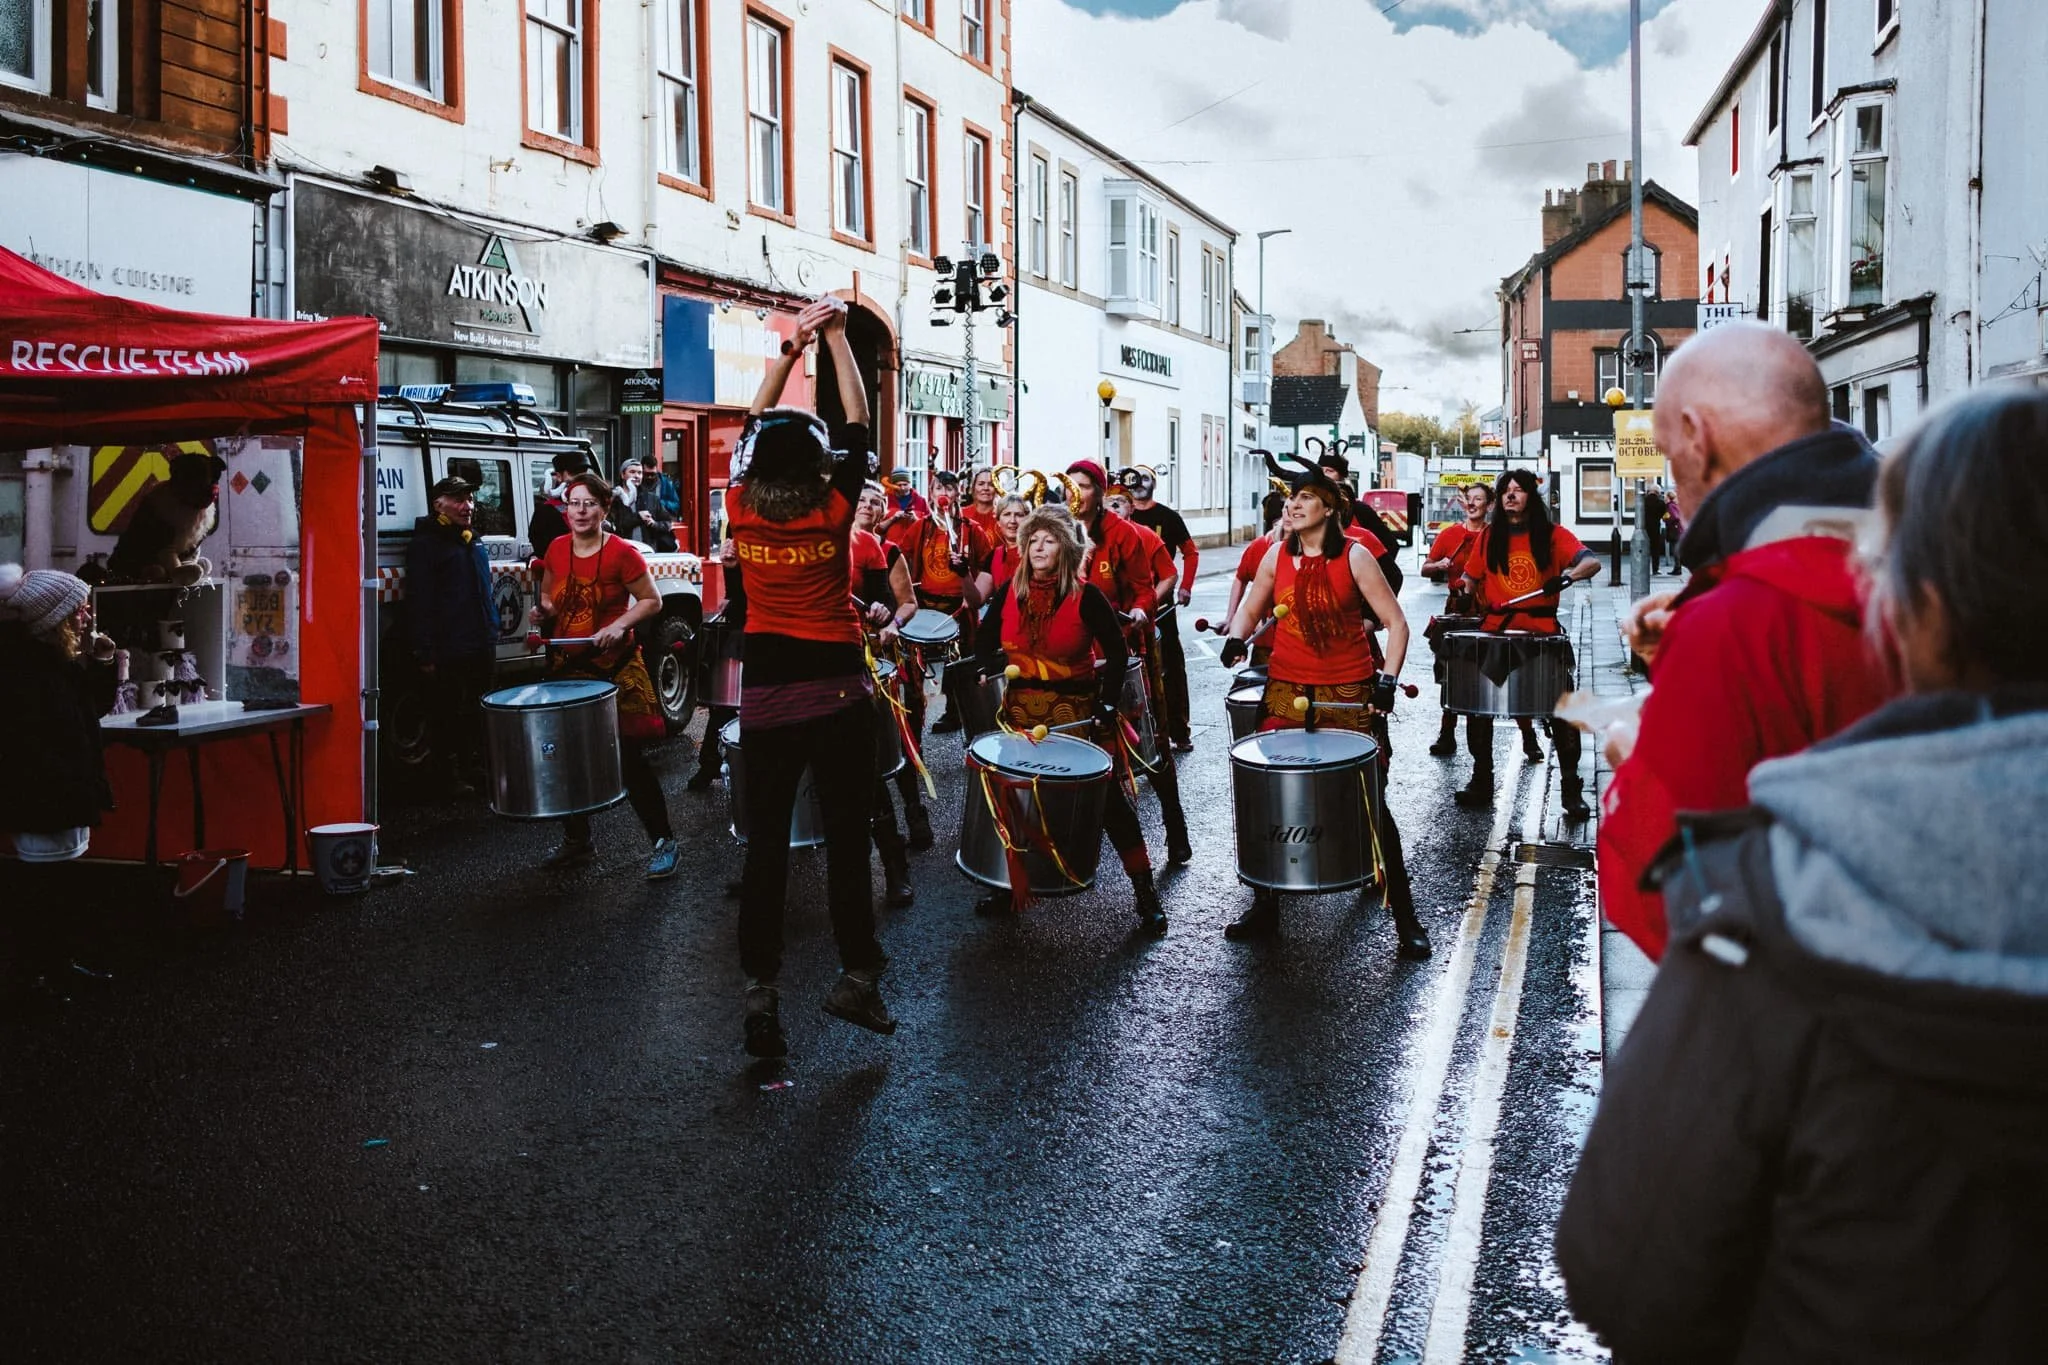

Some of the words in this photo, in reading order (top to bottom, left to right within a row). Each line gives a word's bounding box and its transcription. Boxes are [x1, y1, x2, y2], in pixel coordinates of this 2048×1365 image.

[21, 252, 104, 281] NDIAN
[112, 266, 195, 296] CUISINE
[448, 263, 548, 312] ATKINSON
[296, 310, 314, 322] Bring
[1705, 307, 1736, 318] THE
[10, 340, 159, 374] RESCUE
[153, 350, 250, 375] TEAM
[623, 378, 660, 386] ATKINSON
[918, 373, 957, 398] PIZZA
[1568, 440, 1600, 453] THE
[738, 541, 836, 565] BELONG
